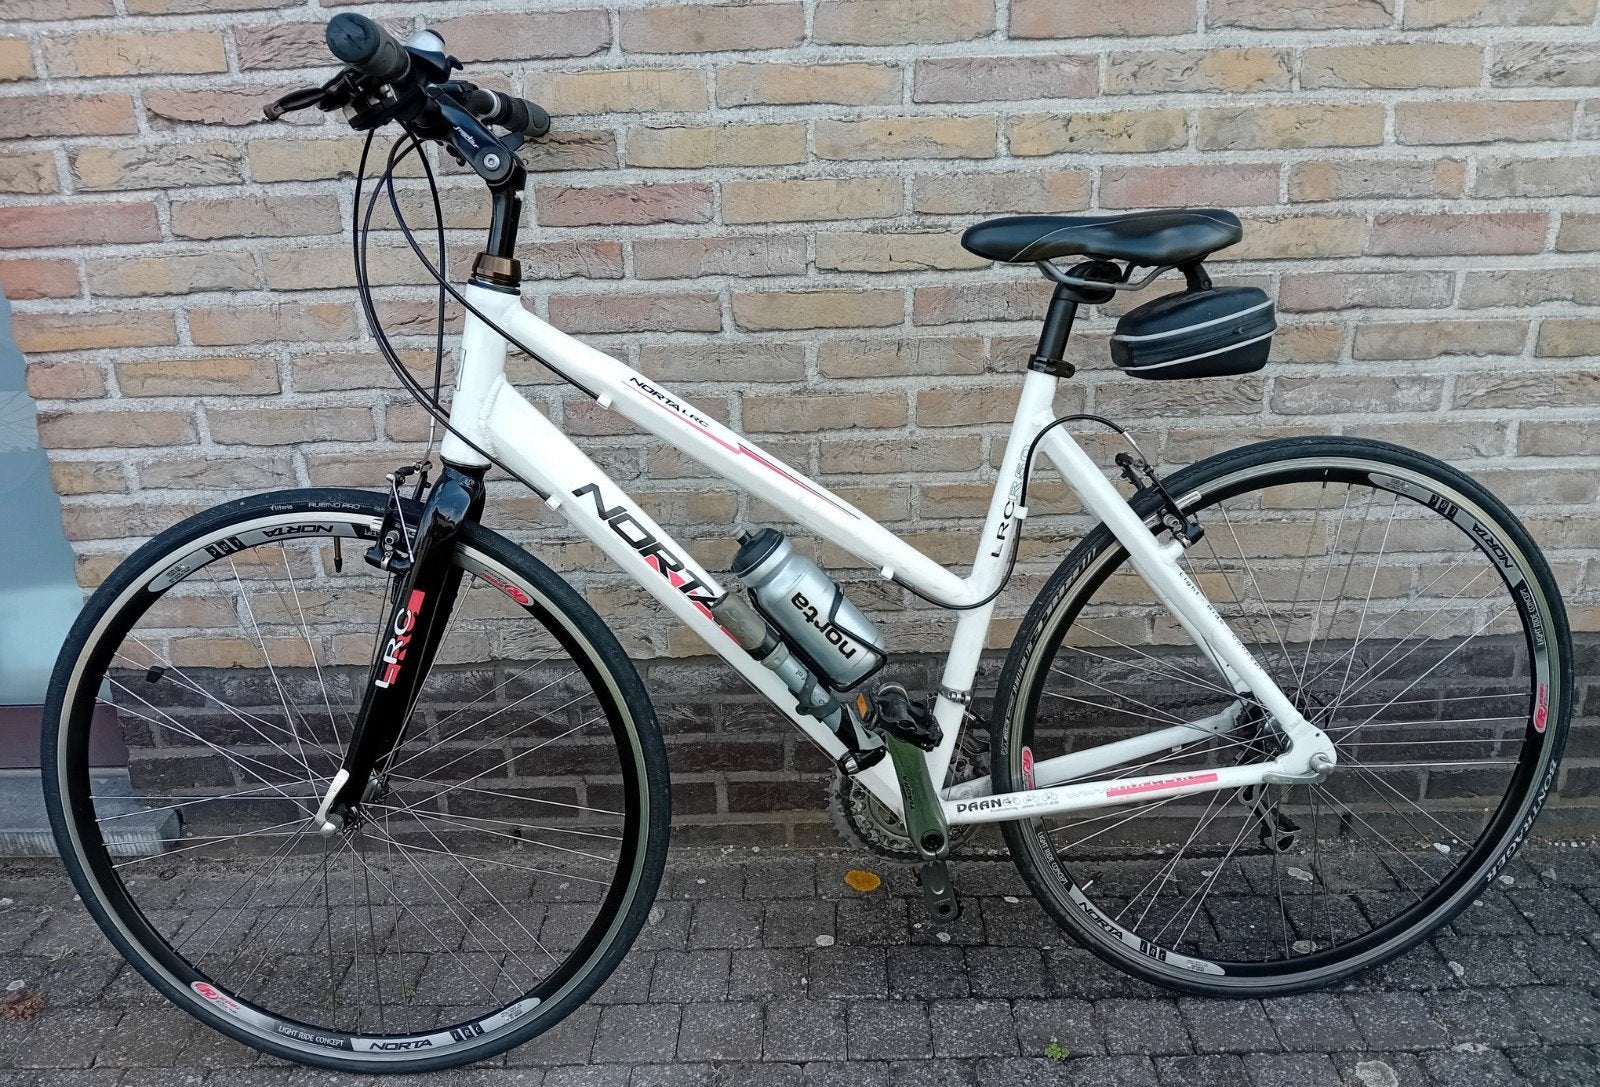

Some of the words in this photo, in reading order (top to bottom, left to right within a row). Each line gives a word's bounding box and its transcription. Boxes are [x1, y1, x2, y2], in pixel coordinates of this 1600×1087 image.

[629, 377, 680, 412] NORTA
[681, 409, 709, 428] LRC
[261, 524, 334, 537] NORTA
[1472, 521, 1514, 569] NORTA
[790, 591, 857, 660] norta
[375, 608, 411, 689] LRC
[956, 798, 1002, 814] DAAN
[1486, 759, 1558, 882] BONTRAGER
[1079, 902, 1123, 940] NORTA
[278, 1025, 297, 1036] LIGHT
[298, 1031, 314, 1041] RIDE
[315, 1035, 344, 1046] CONCEPT
[369, 1038, 433, 1050] NORTA
